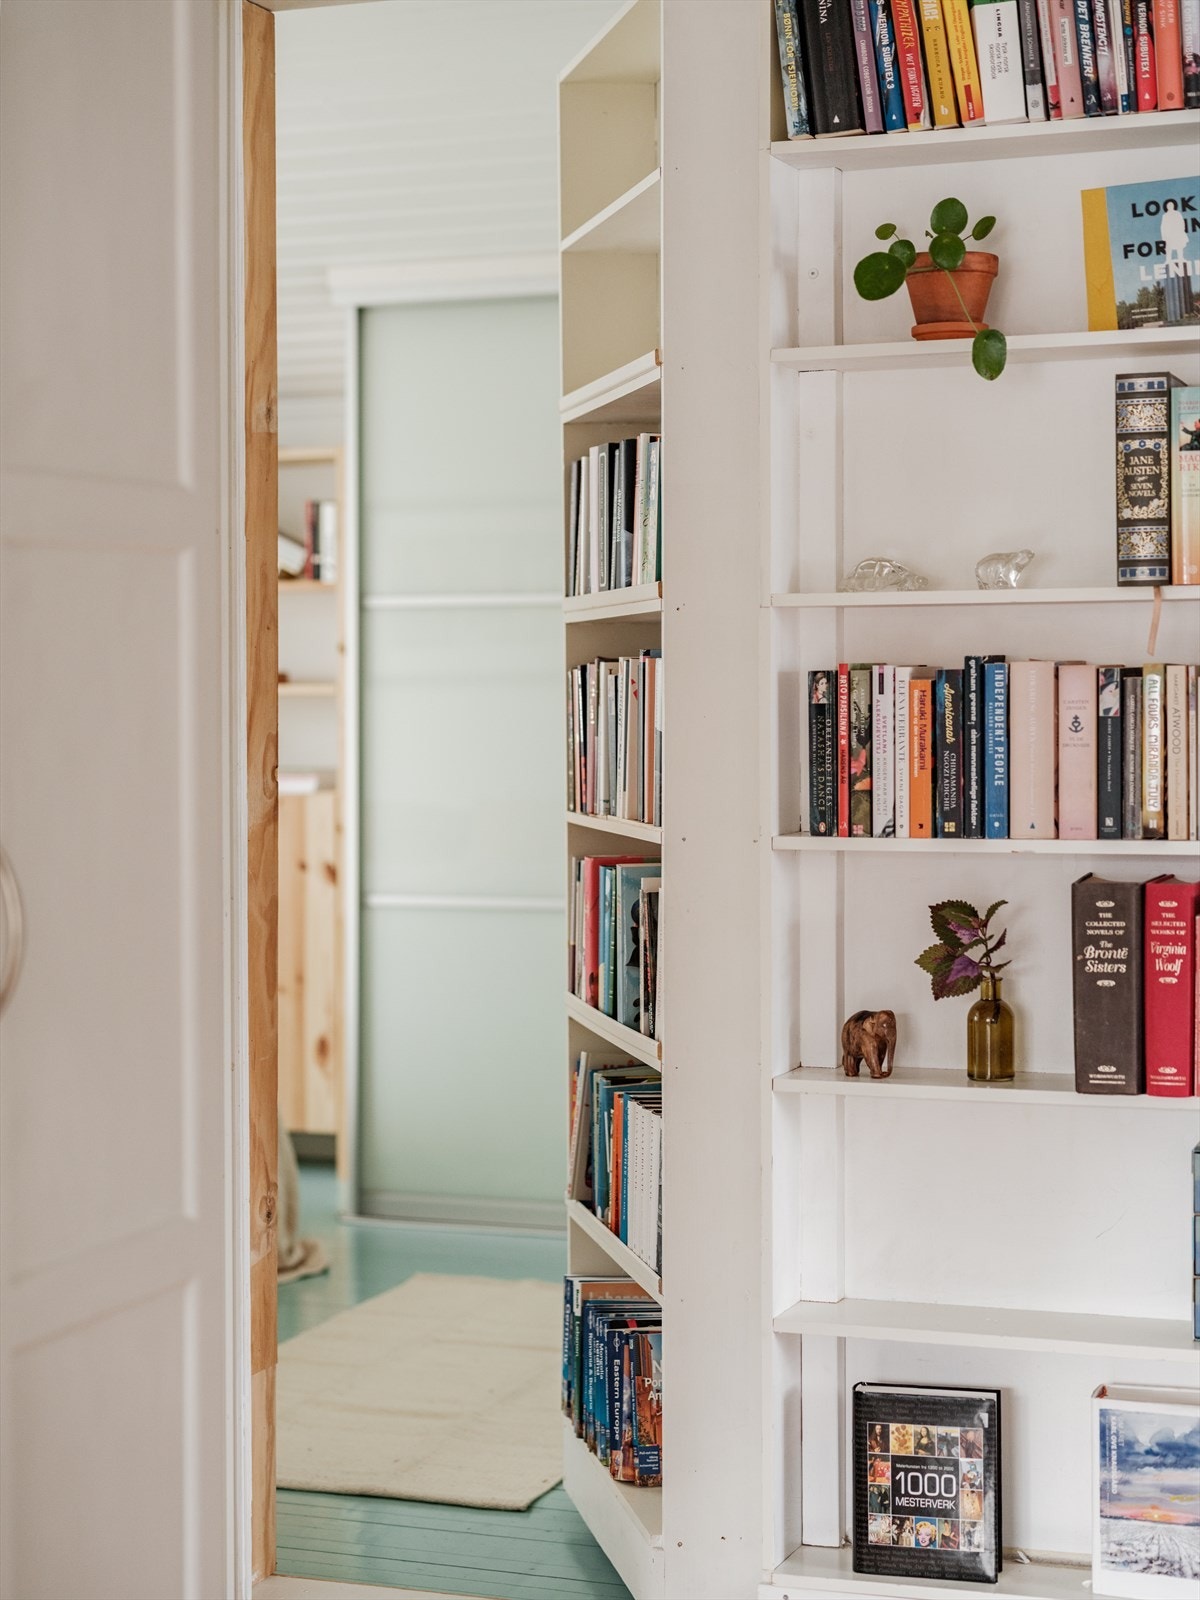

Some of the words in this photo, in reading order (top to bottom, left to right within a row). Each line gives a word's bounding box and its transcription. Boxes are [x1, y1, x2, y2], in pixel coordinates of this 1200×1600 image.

[1077, 0, 1088, 20] DET
[1138, 2, 1147, 34] VERNON
[783, 12, 793, 39] BØNN
[879, 13, 890, 45] VERNON
[786, 41, 796, 58] FOR
[932, 38, 942, 68] REBECCA
[1080, 24, 1094, 77] BRENNER!
[1140, 36, 1150, 72] SUBUTEX
[1185, 23, 1193, 65] ISTANBUL
[882, 46, 893, 81] SUBUTEX
[906, 53, 915, 66] VIET
[989, 44, 997, 79] skoleordbok
[787, 60, 800, 111] TSJERNOBYL
[909, 85, 922, 107] NGUYEN
[1131, 195, 1198, 218] LOOK
[1122, 240, 1167, 259] FOR
[1124, 465, 1160, 476] AUSTEN
[1129, 455, 1154, 466] JANE
[1128, 490, 1156, 498] NOVELS
[839, 675, 847, 694] ARTO
[968, 659, 977, 691] graham
[1147, 678, 1159, 695] ALL
[898, 680, 906, 710] ELENA
[919, 689, 928, 720] Haruki
[994, 669, 1005, 741] INDEPENDENT
[839, 695, 848, 736] PAASILINNA
[943, 683, 956, 744] Americanah
[1147, 698, 1159, 729] FOURS
[817, 715, 826, 772] NATASHA'S
[851, 728, 859, 749] Things
[898, 713, 906, 764] FERRANTE
[969, 729, 978, 745] den
[1171, 707, 1181, 755] ATWOOD
[919, 723, 928, 770] Murakami
[1147, 734, 1159, 781] MIRANDA
[968, 745, 978, 799] menneskelige
[994, 746, 1005, 787] PEOPLE
[817, 775, 826, 811] DANCE
[1147, 784, 1159, 809] JULY
[1084, 944, 1129, 960] Brontë
[1099, 940, 1113, 949] The
[1150, 941, 1187, 957] Virginia
[1084, 960, 1127, 974] Sisters
[1155, 958, 1184, 976] Woolf
[613, 1359, 621, 1399] Eastern
[1110, 1416, 1118, 1434] KARL
[1110, 1435, 1118, 1449] OVE
[895, 1471, 957, 1498] 1000
[895, 1496, 957, 1511] MESTERVERK
